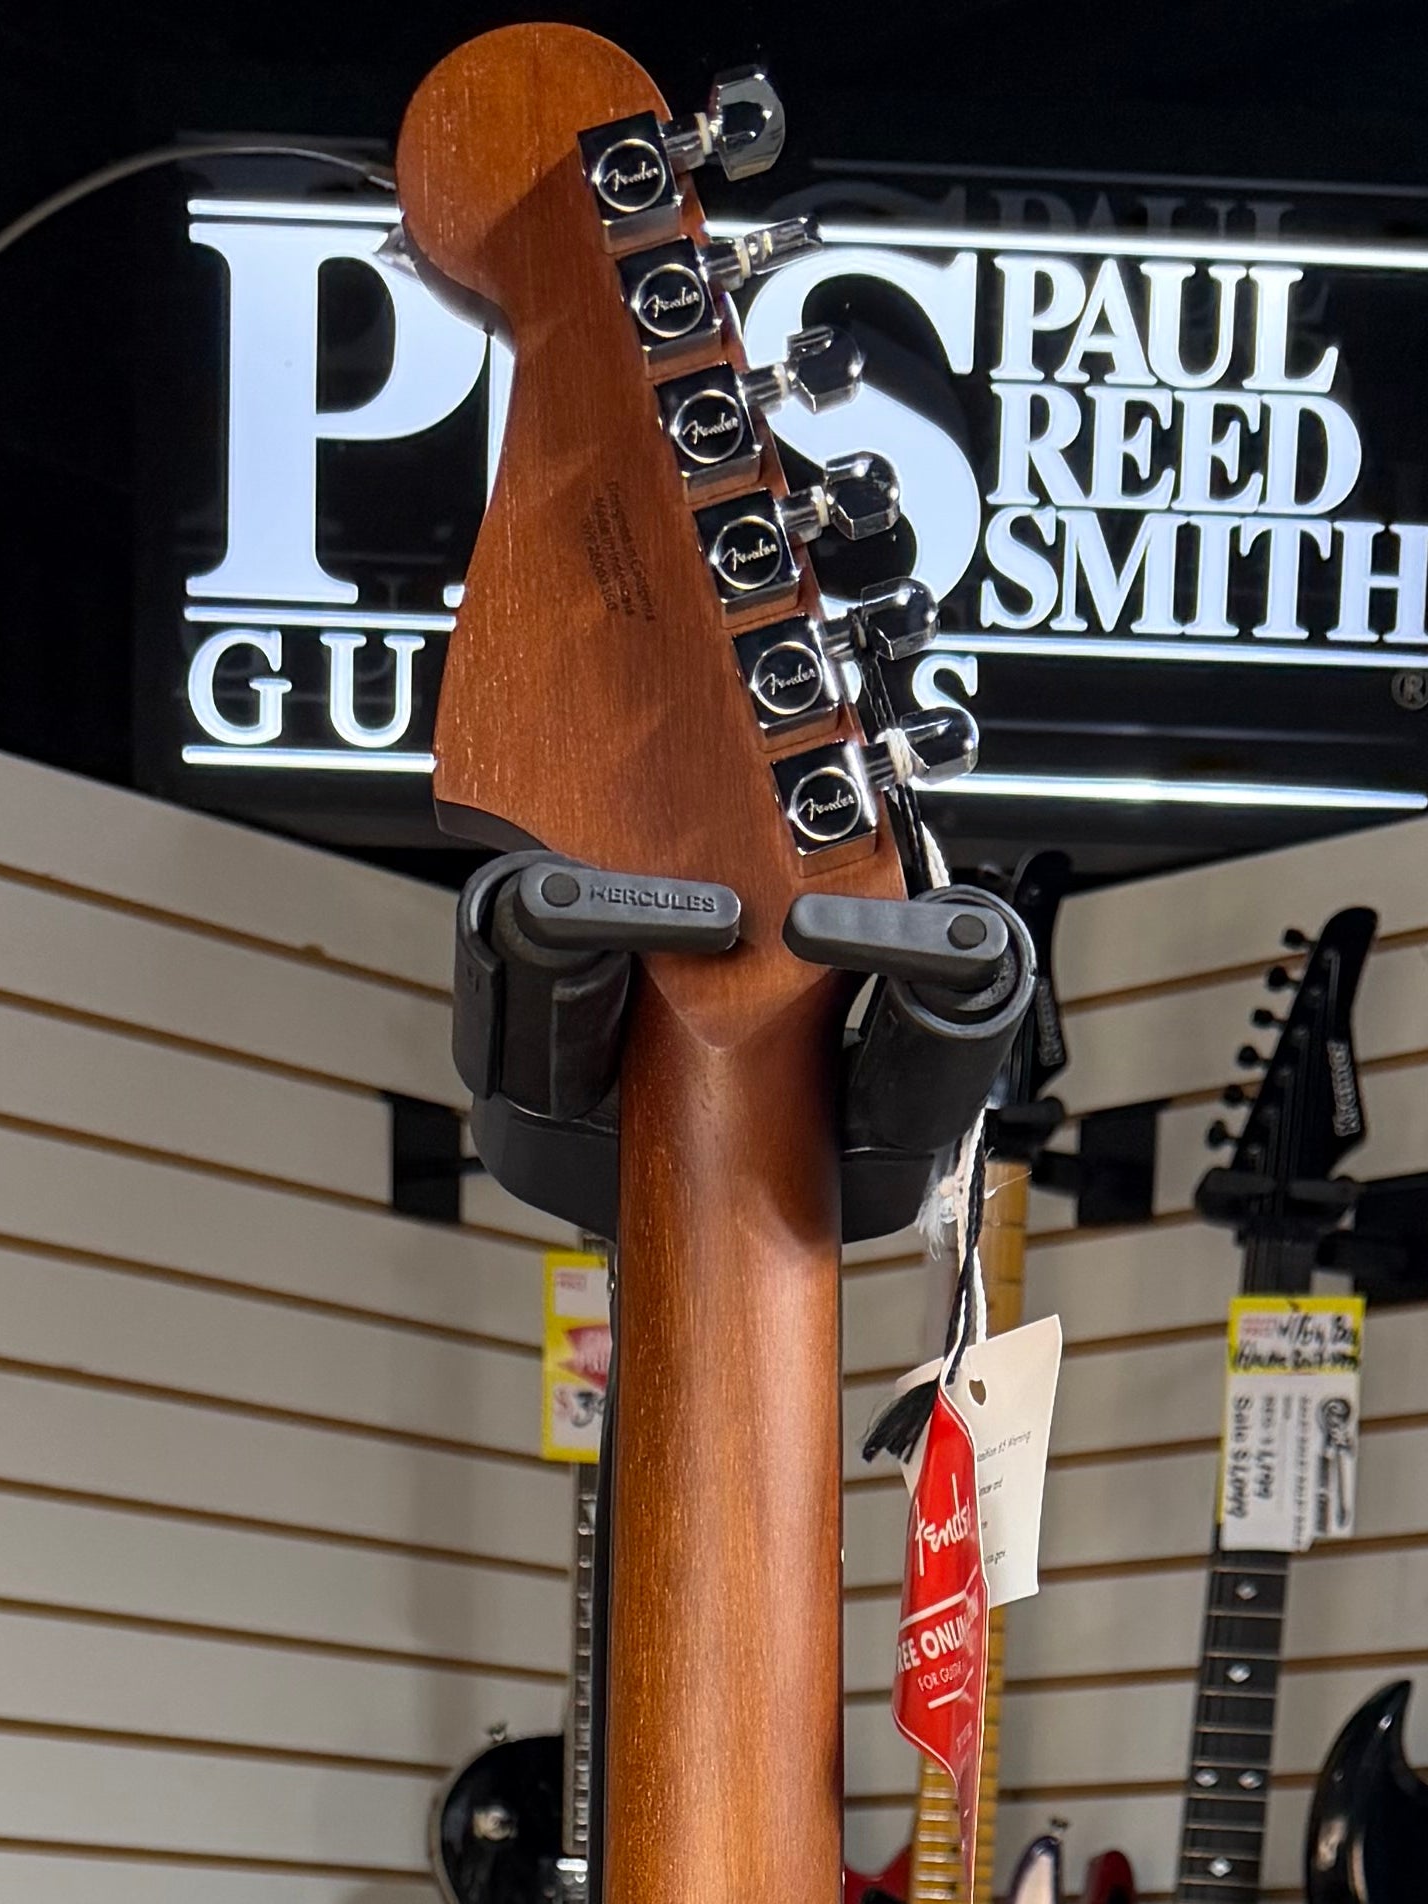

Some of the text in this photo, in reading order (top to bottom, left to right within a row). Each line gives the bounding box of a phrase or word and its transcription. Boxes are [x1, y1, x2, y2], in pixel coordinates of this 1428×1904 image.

[989, 254, 1340, 394] PAUL
[985, 382, 1363, 515] REED
[588, 883, 718, 914] HERCULES
